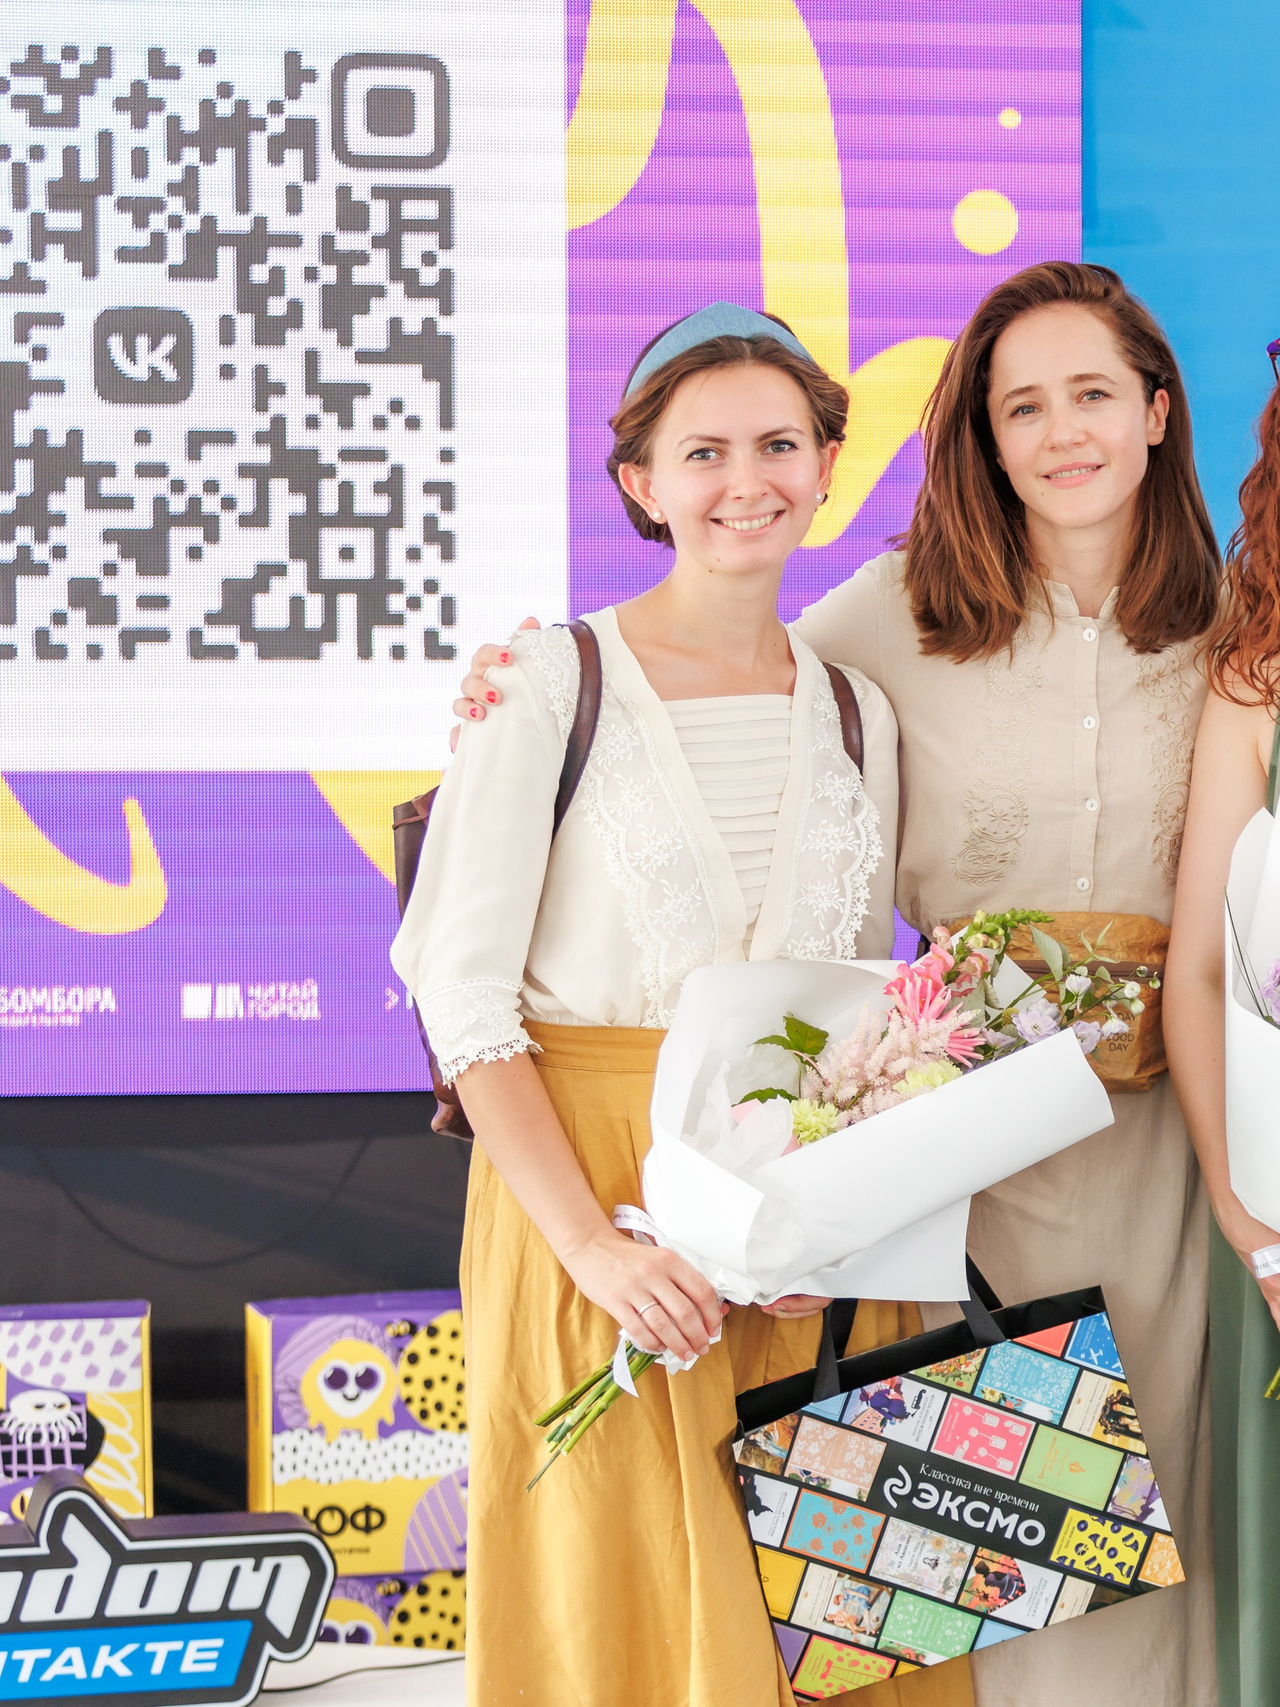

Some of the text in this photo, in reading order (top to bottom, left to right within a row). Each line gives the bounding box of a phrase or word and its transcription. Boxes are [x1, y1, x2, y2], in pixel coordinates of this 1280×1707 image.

[919, 1463, 1040, 1513] Классика вне времени
[303, 1504, 385, 1537] ЮФ
[912, 1482, 1046, 1547] ЭКСМО
[0, 1638, 225, 1684] ТАКТЕ
